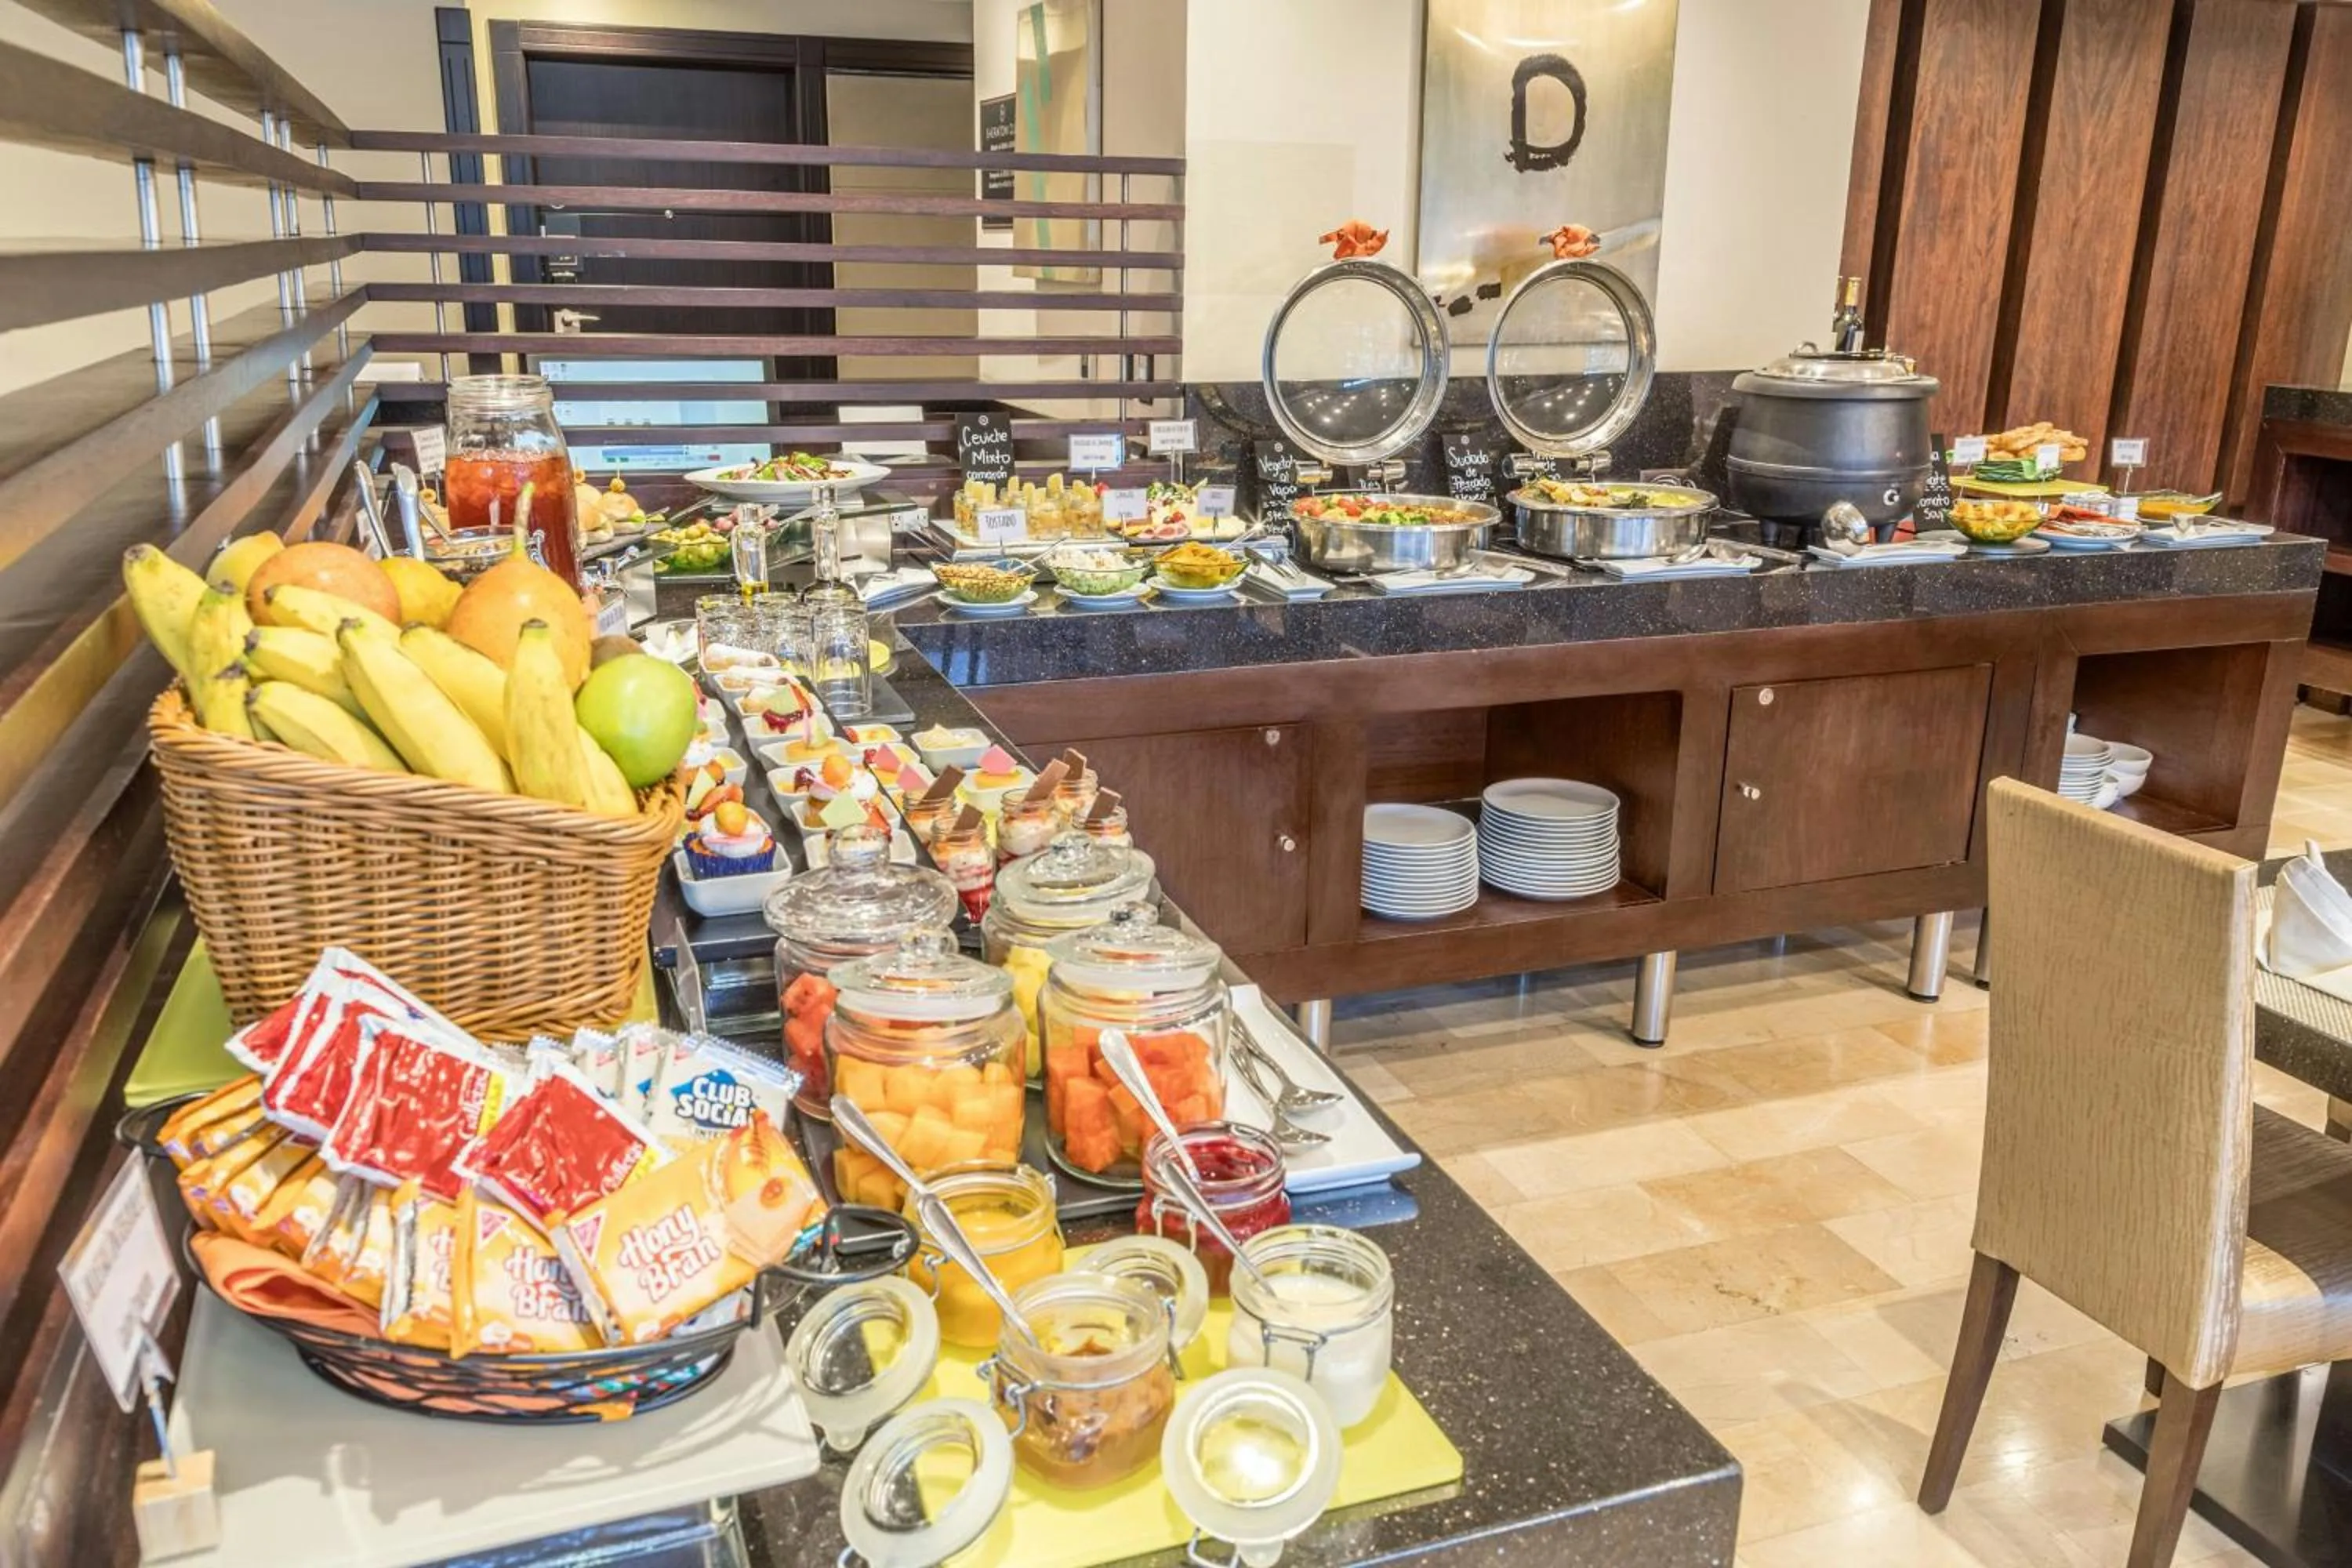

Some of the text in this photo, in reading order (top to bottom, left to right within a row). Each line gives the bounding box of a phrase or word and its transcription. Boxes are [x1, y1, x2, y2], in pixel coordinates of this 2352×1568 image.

[962, 426, 1007, 447] Ceviche
[971, 448, 1011, 465] Mixto
[1448, 446, 1489, 468] Sudado
[1465, 467, 1478, 477] de
[1917, 494, 1950, 508] omato
[691, 1076, 753, 1109] CLUB
[618, 1203, 701, 1269] Hony
[638, 1235, 721, 1304] Bran
